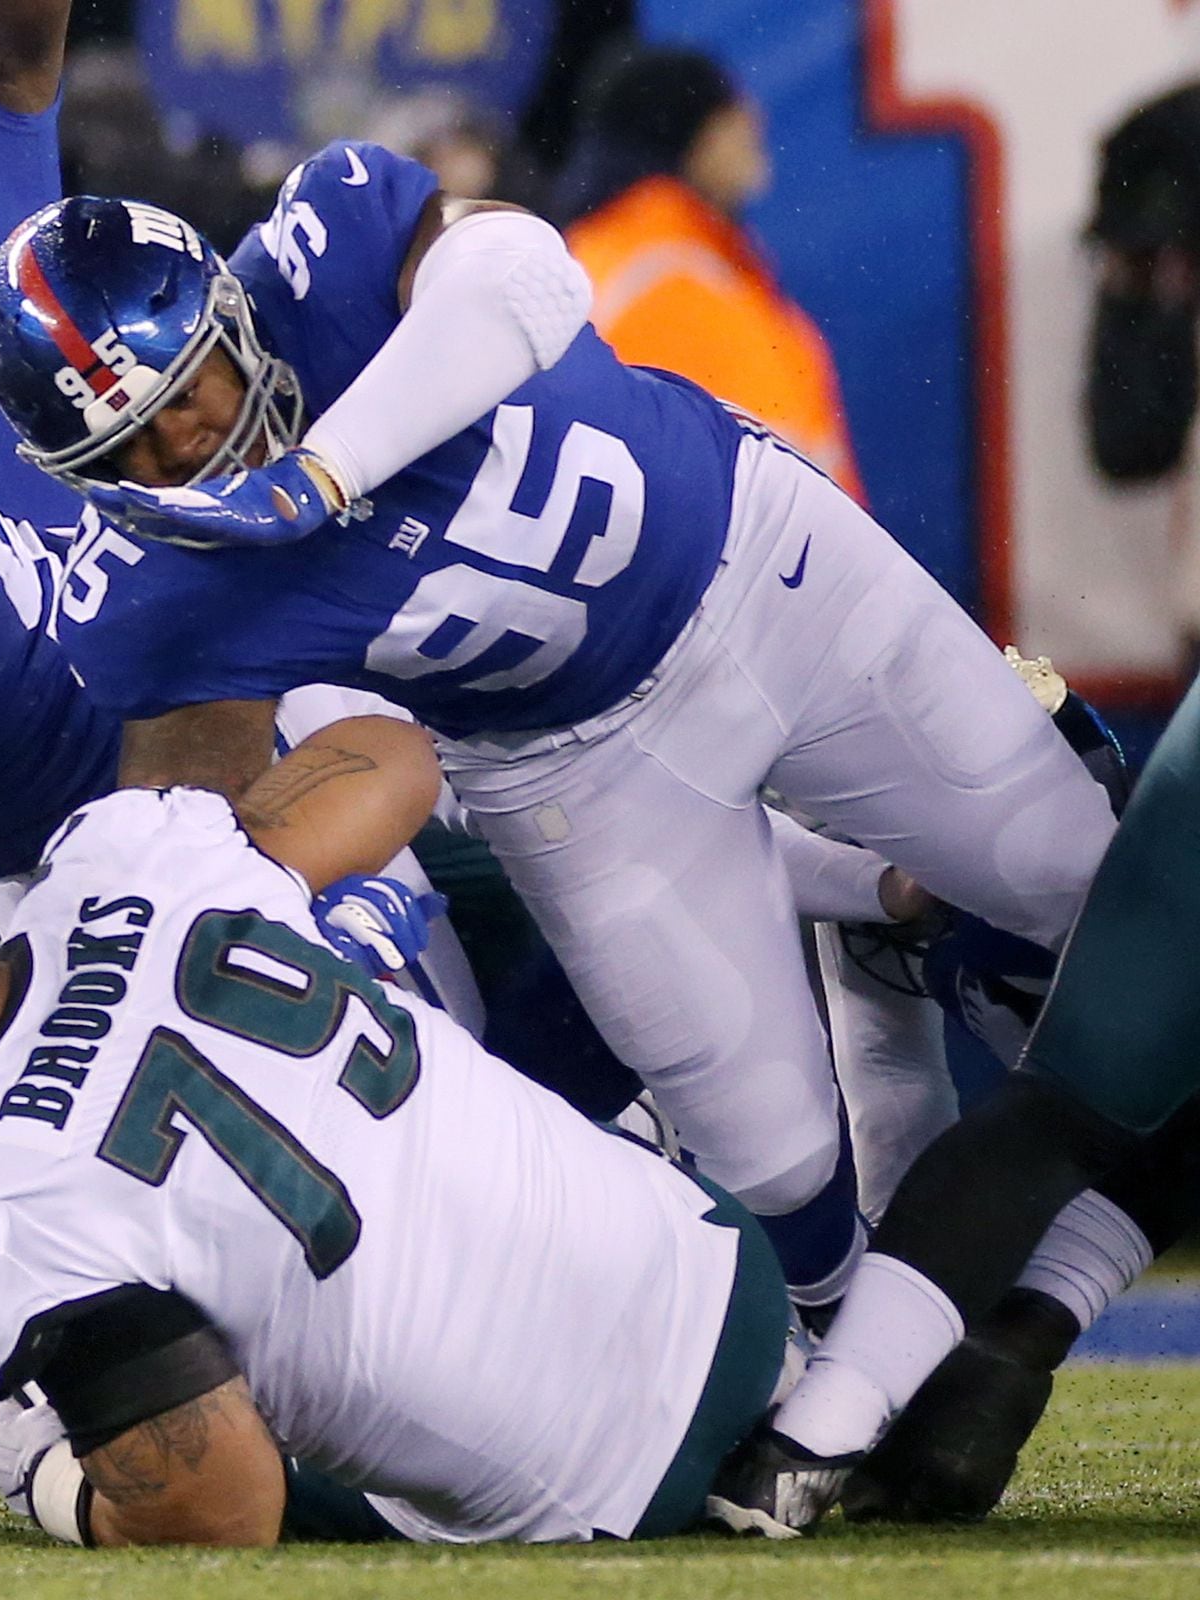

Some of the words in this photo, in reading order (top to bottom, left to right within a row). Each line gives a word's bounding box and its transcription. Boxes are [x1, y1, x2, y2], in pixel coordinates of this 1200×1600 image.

[54, 326, 138, 410] 95
[363, 403, 646, 691] 95
[95, 907, 422, 1282] 79
